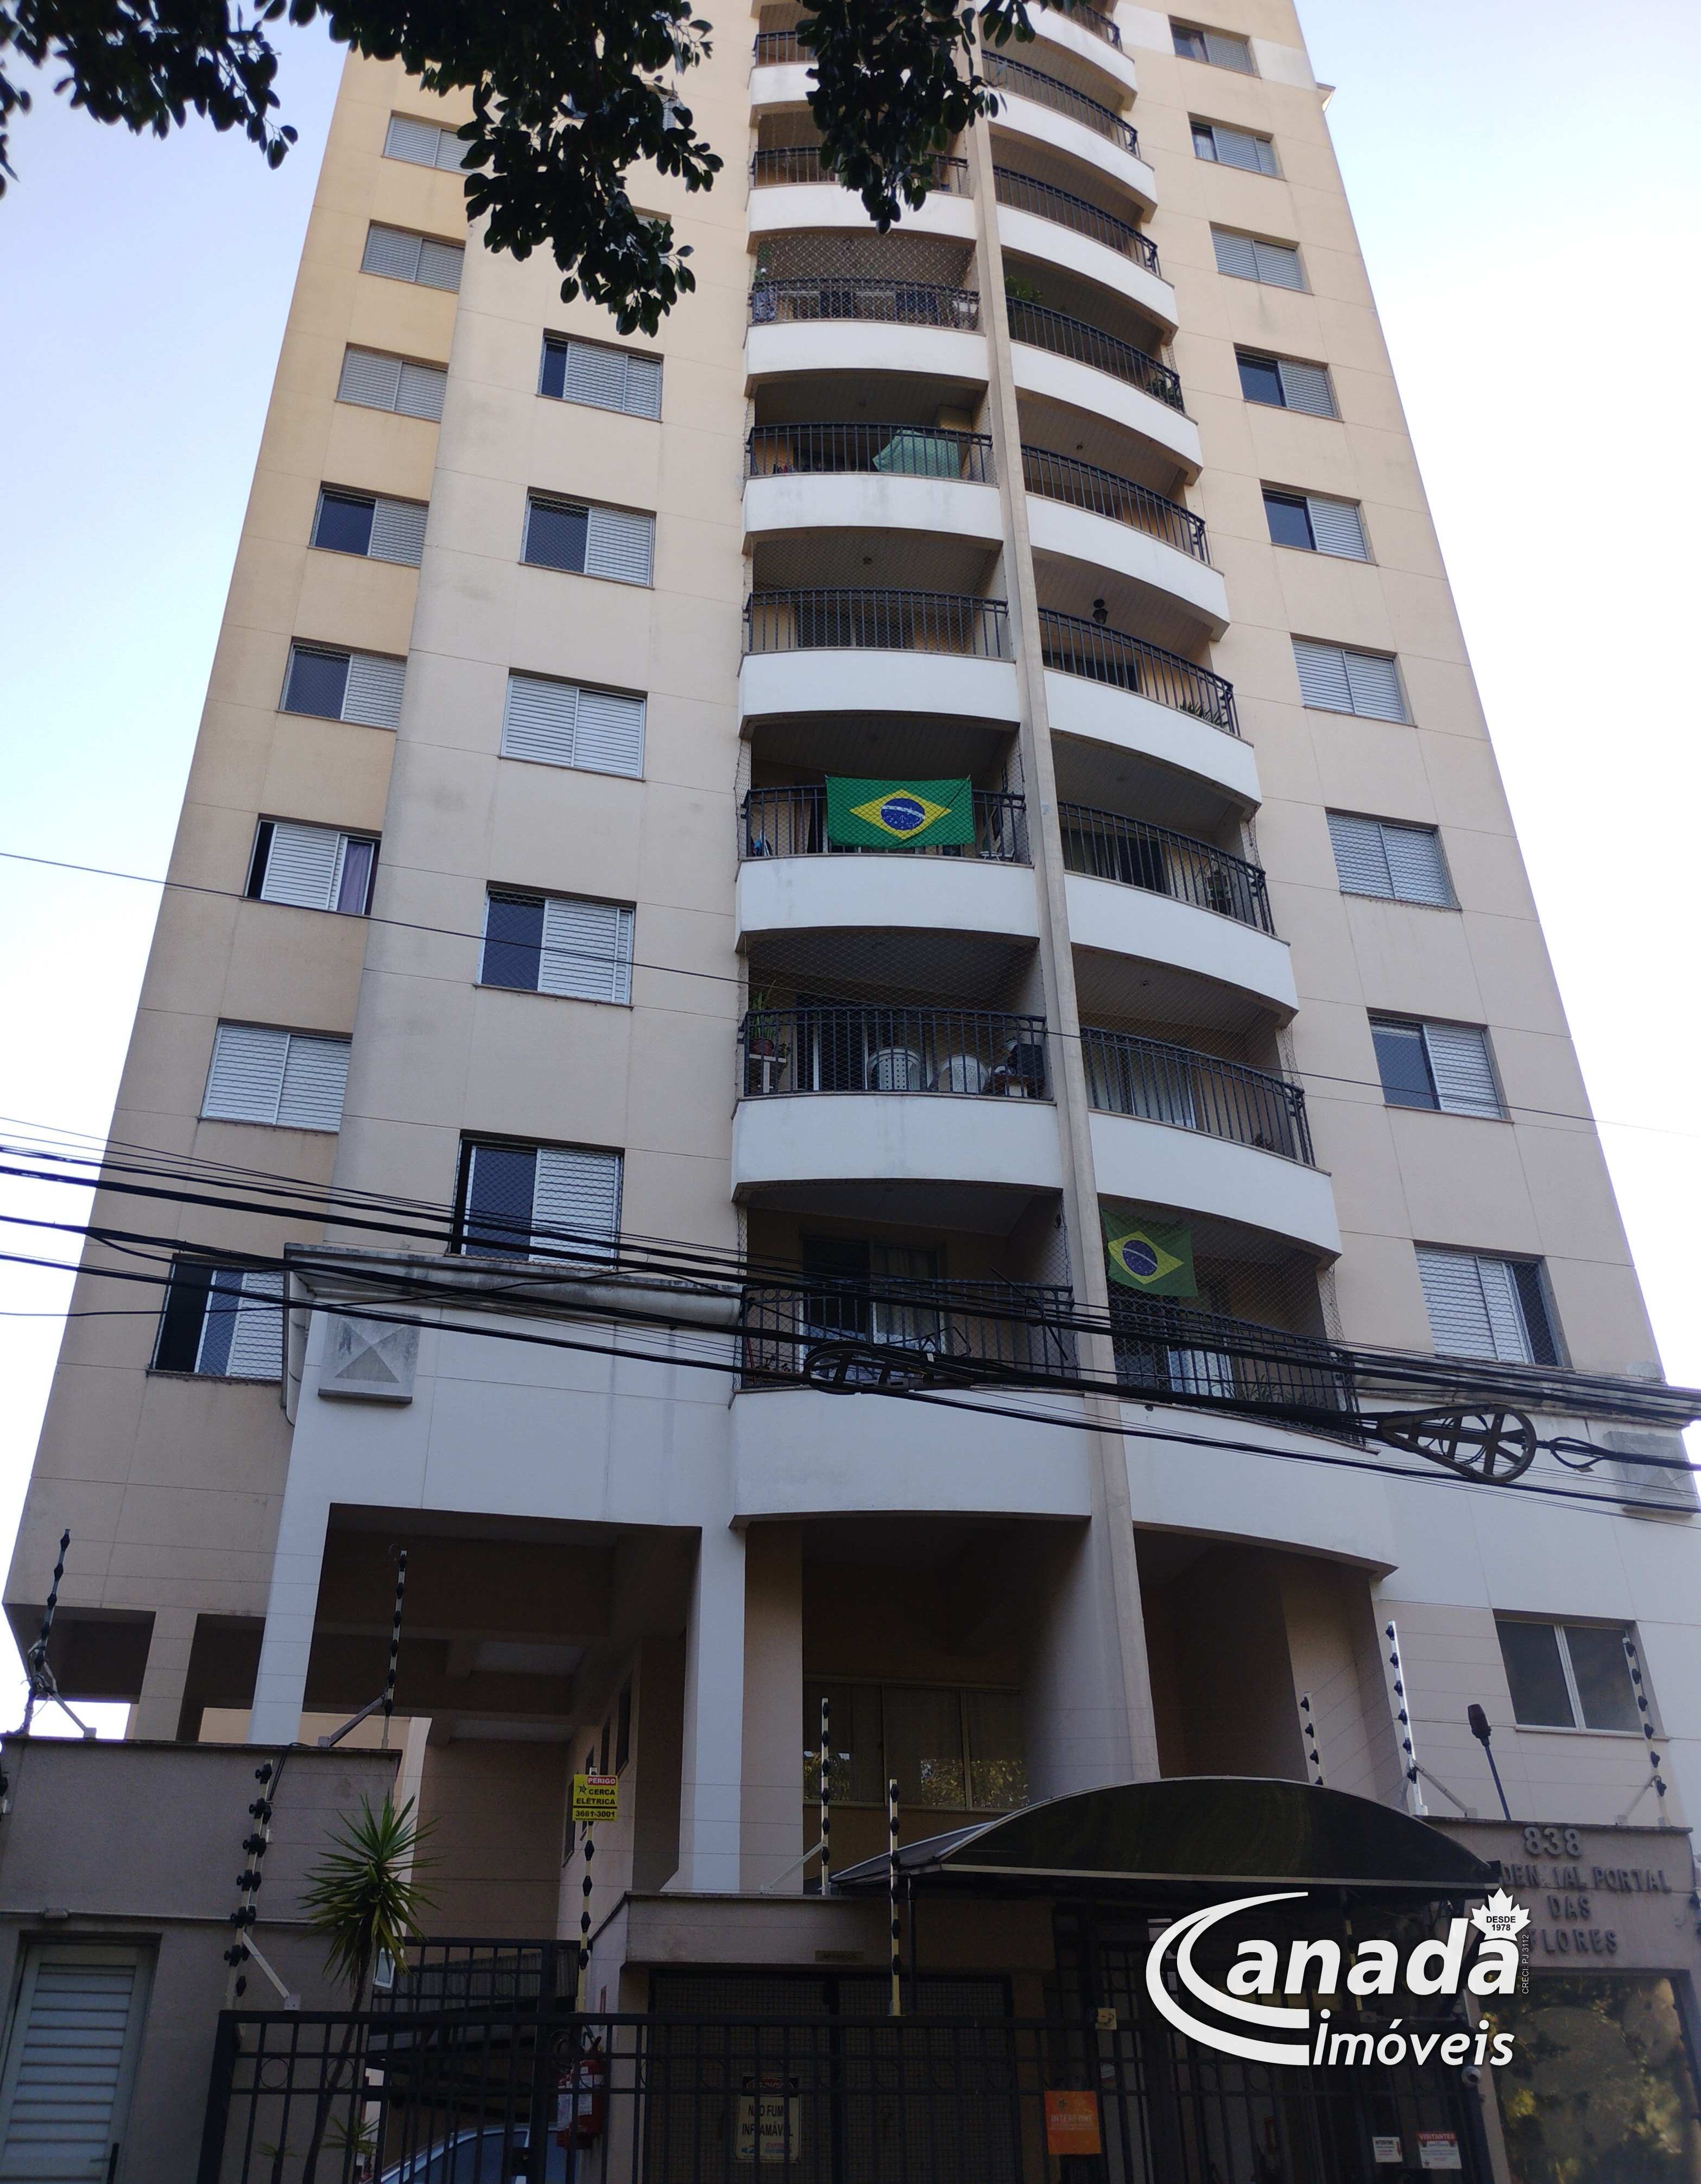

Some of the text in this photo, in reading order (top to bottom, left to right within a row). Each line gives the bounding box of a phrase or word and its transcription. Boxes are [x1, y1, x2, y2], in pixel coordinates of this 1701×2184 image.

[1523, 1827, 1584, 1857] 838
[1592, 1866, 1672, 1892] PORTAL
[1547, 1893, 1592, 1921] DAS
[1526, 1928, 1619, 1955] FLORES
[748, 2104, 787, 2117] NO FUM
[742, 2120, 793, 2136] INFAMÁVL
